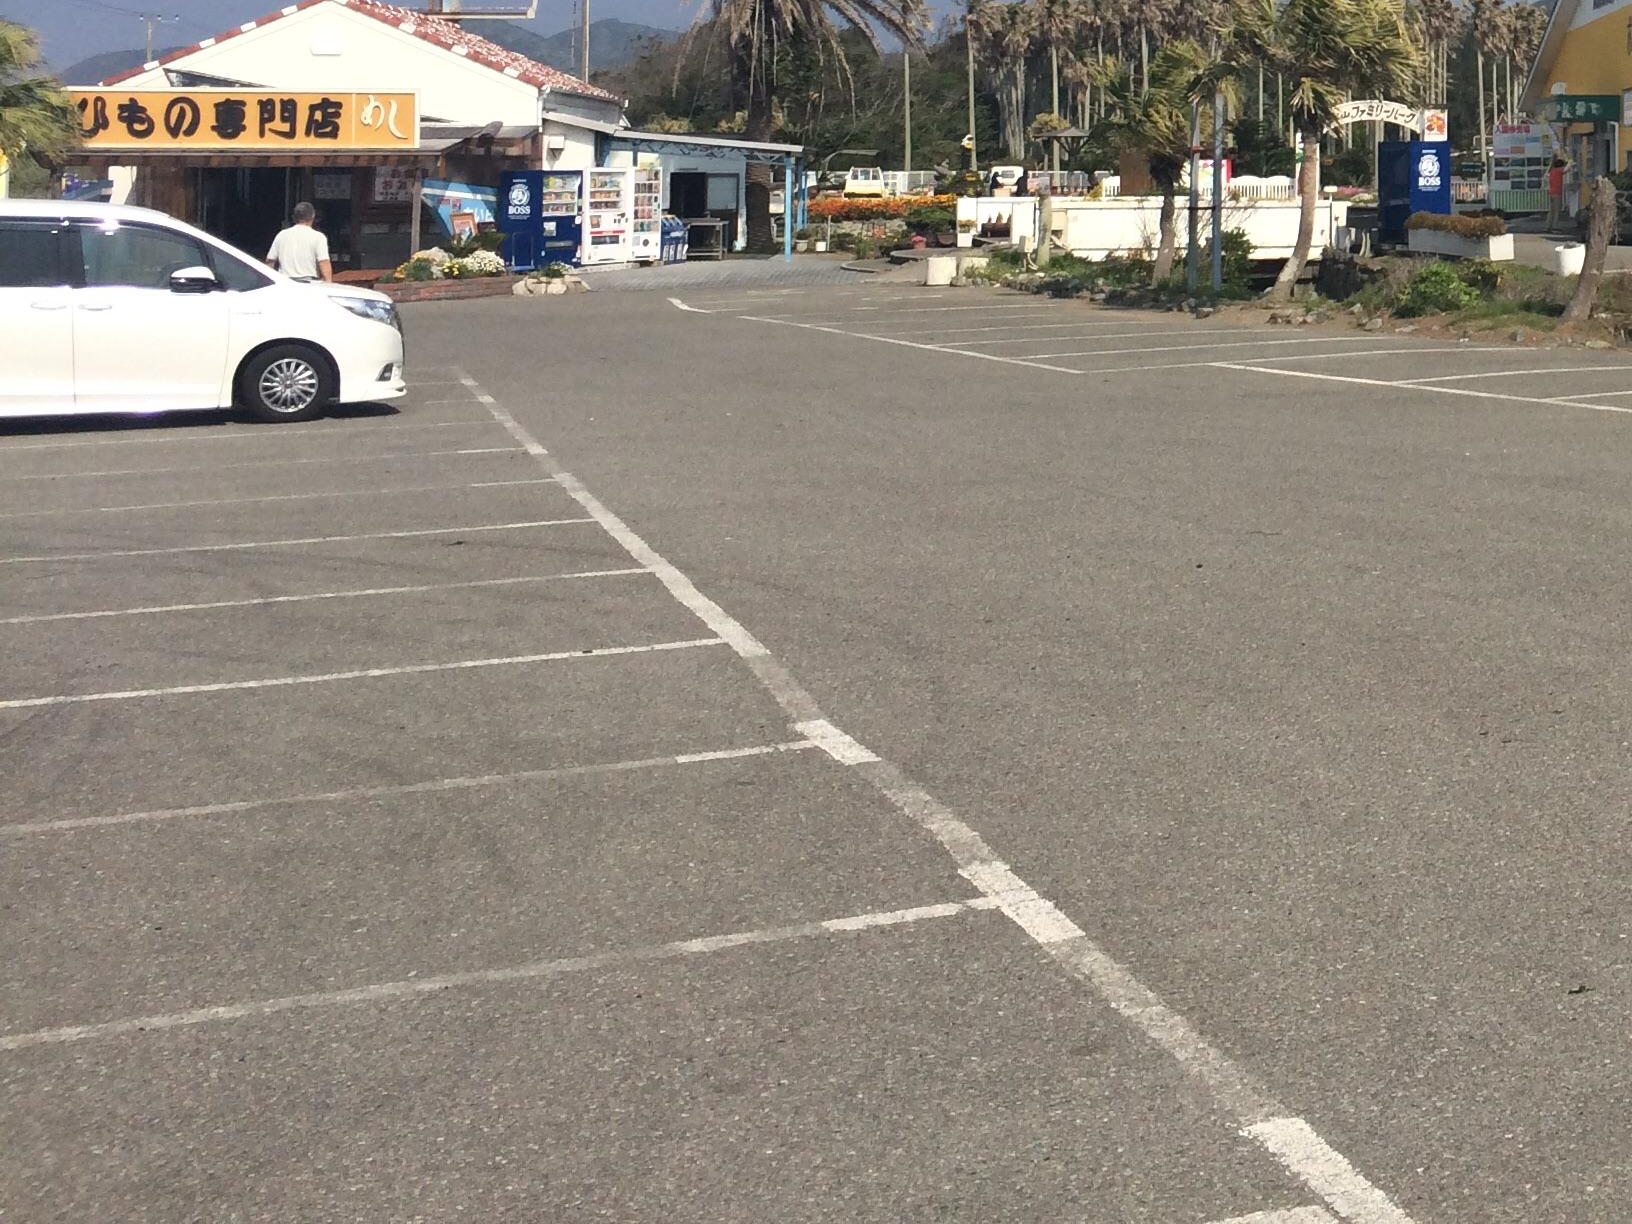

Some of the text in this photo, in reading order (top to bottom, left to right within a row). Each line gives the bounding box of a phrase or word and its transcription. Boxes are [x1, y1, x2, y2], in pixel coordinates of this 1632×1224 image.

[78, 94, 408, 140] ひもの専門店 めし
[1418, 176, 1441, 187] BOSS
[508, 205, 531, 215] BOSS
